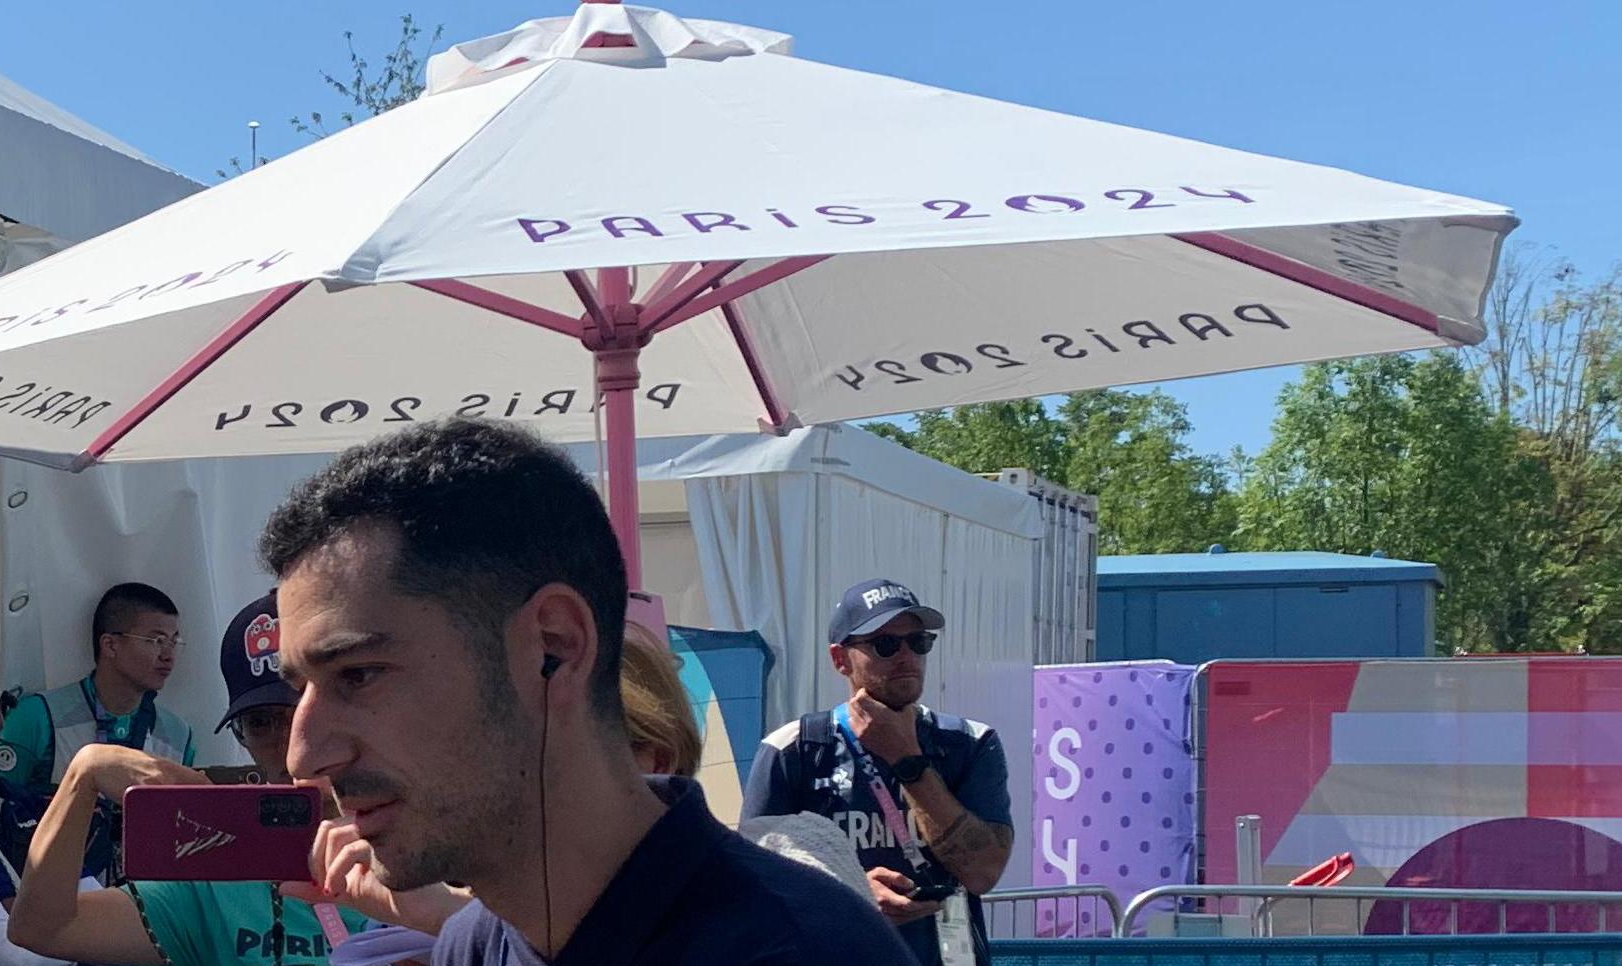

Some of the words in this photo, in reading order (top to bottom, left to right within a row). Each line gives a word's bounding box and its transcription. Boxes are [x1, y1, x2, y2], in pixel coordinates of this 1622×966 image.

[922, 184, 1257, 220] 2024
[85, 248, 294, 314] 2024
[235, 927, 334, 958] PARI
